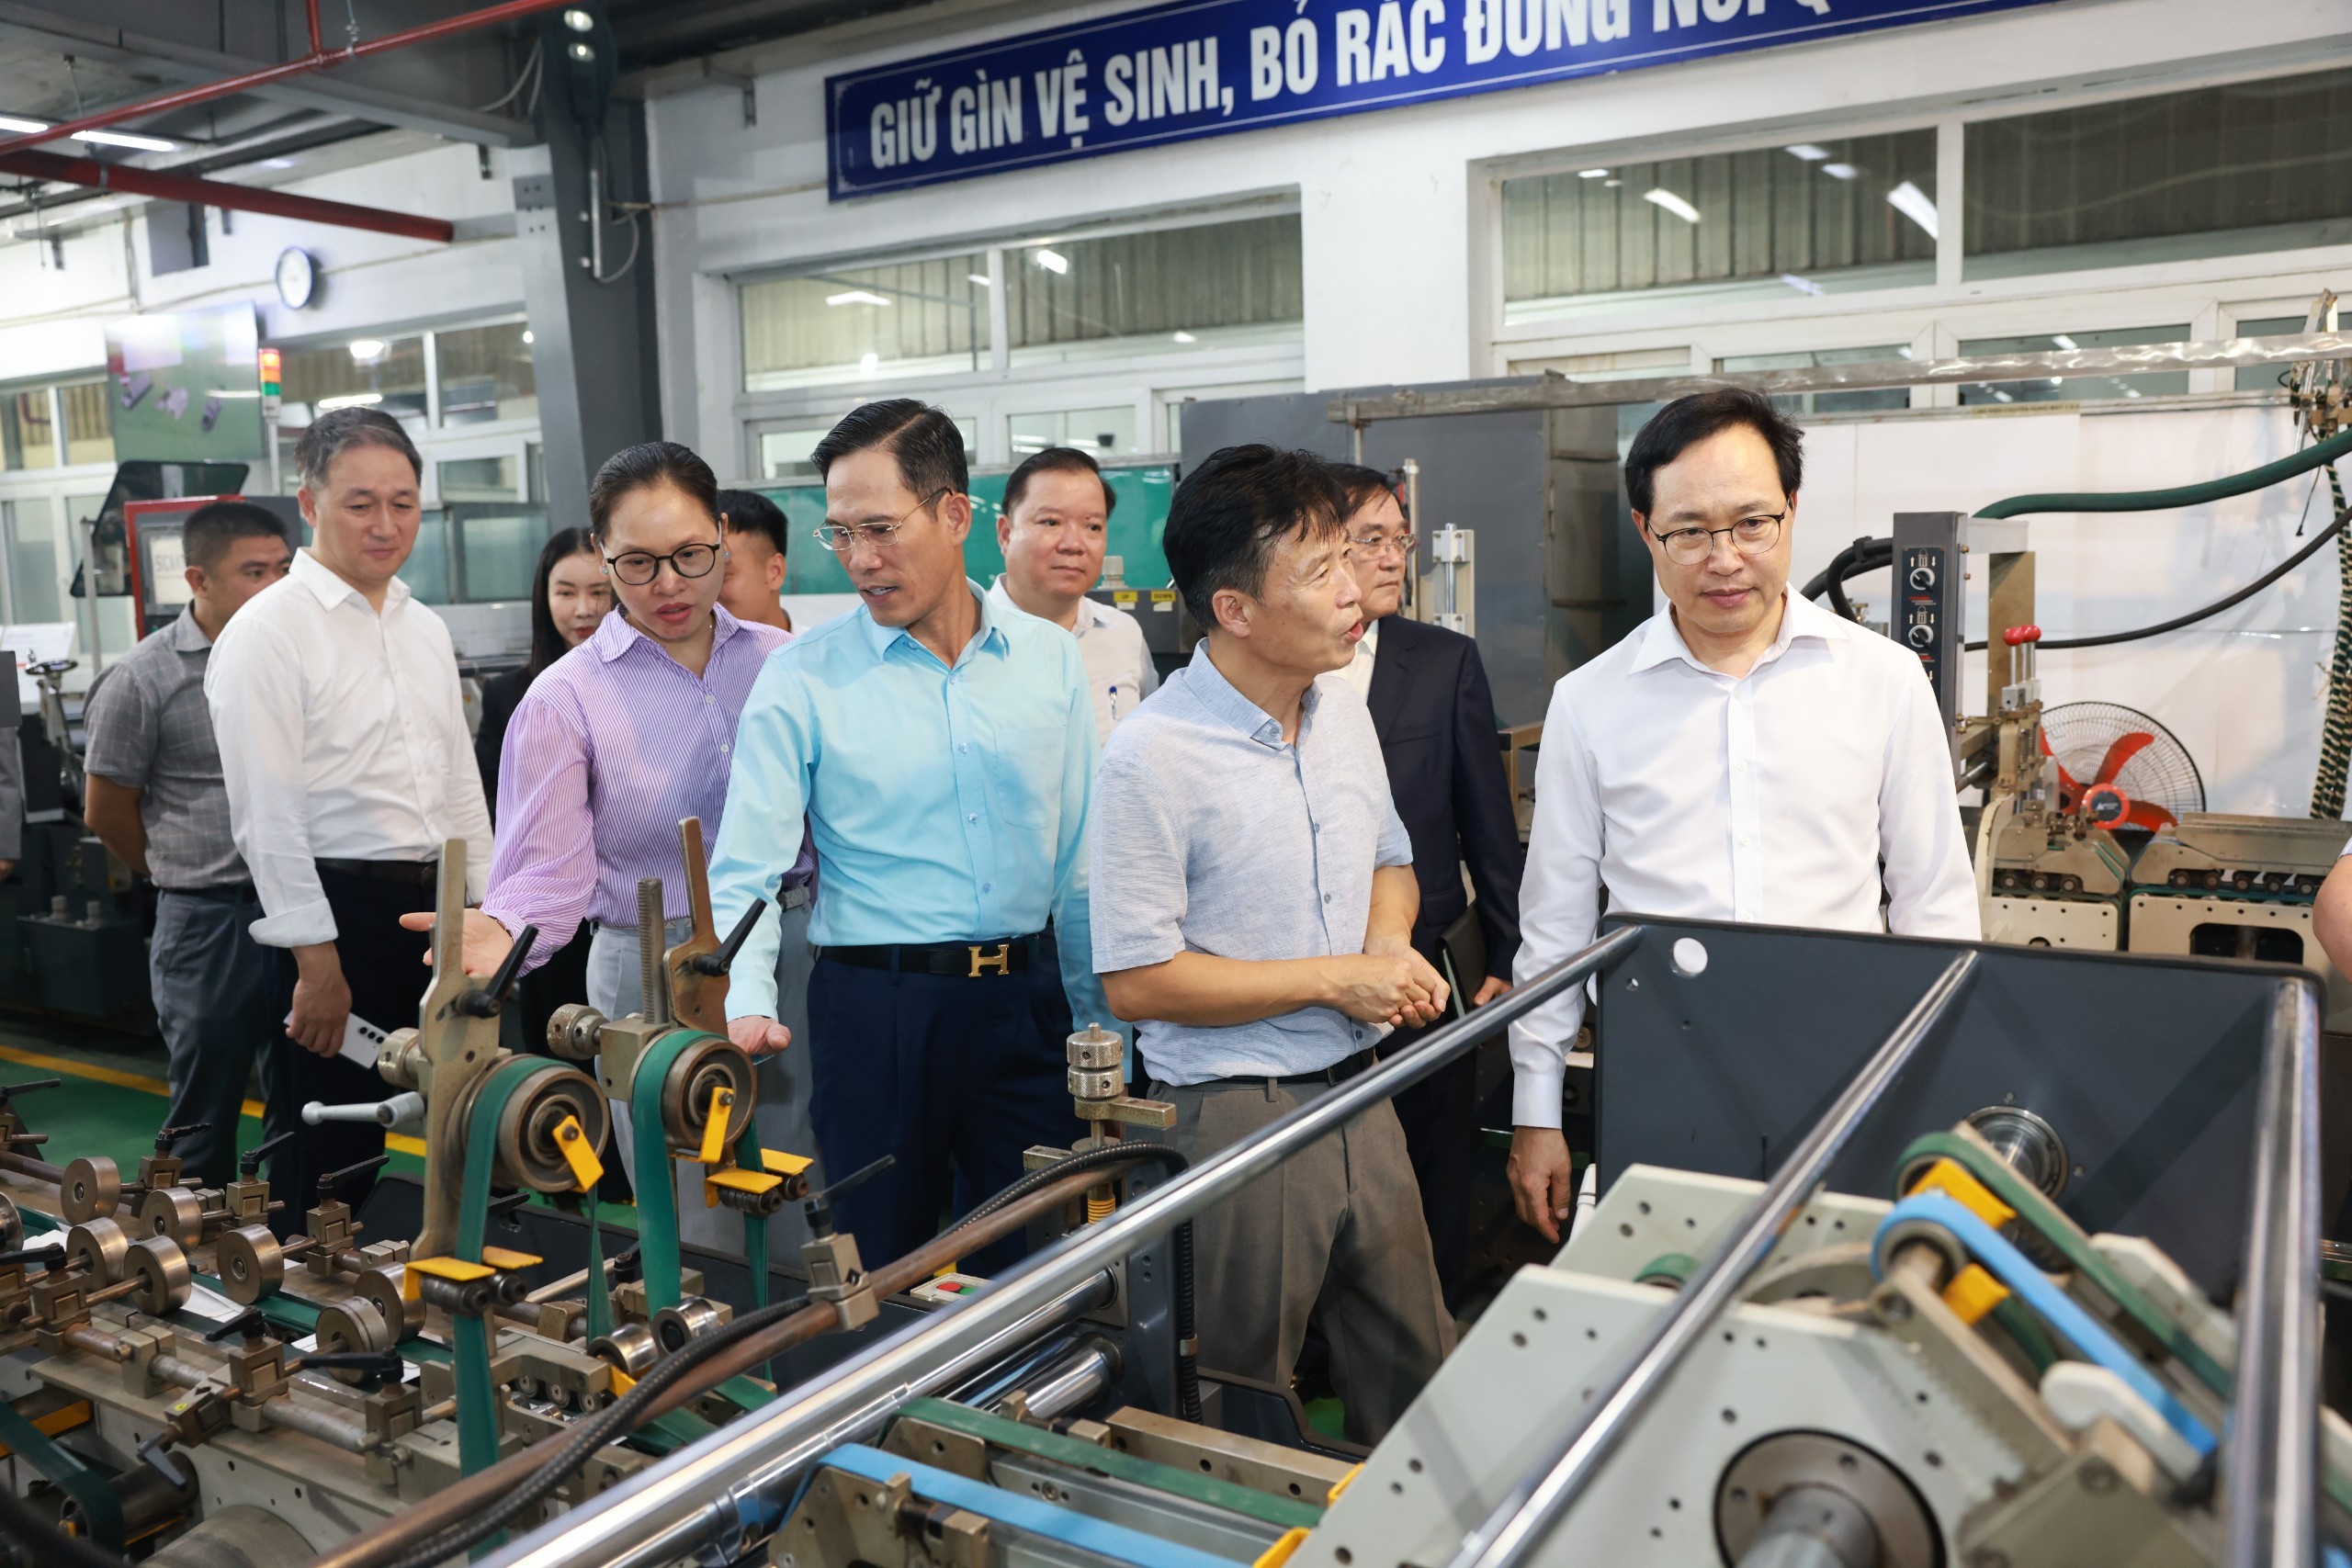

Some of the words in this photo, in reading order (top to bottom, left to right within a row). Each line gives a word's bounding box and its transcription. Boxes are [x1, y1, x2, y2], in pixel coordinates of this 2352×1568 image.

[870, 77, 942, 170] GIỮ
[950, 69, 1023, 155] GÌN
[1035, 48, 1090, 150] VỆ
[1104, 36, 1235, 127] SINH,
[967, 943, 1010, 977] H
